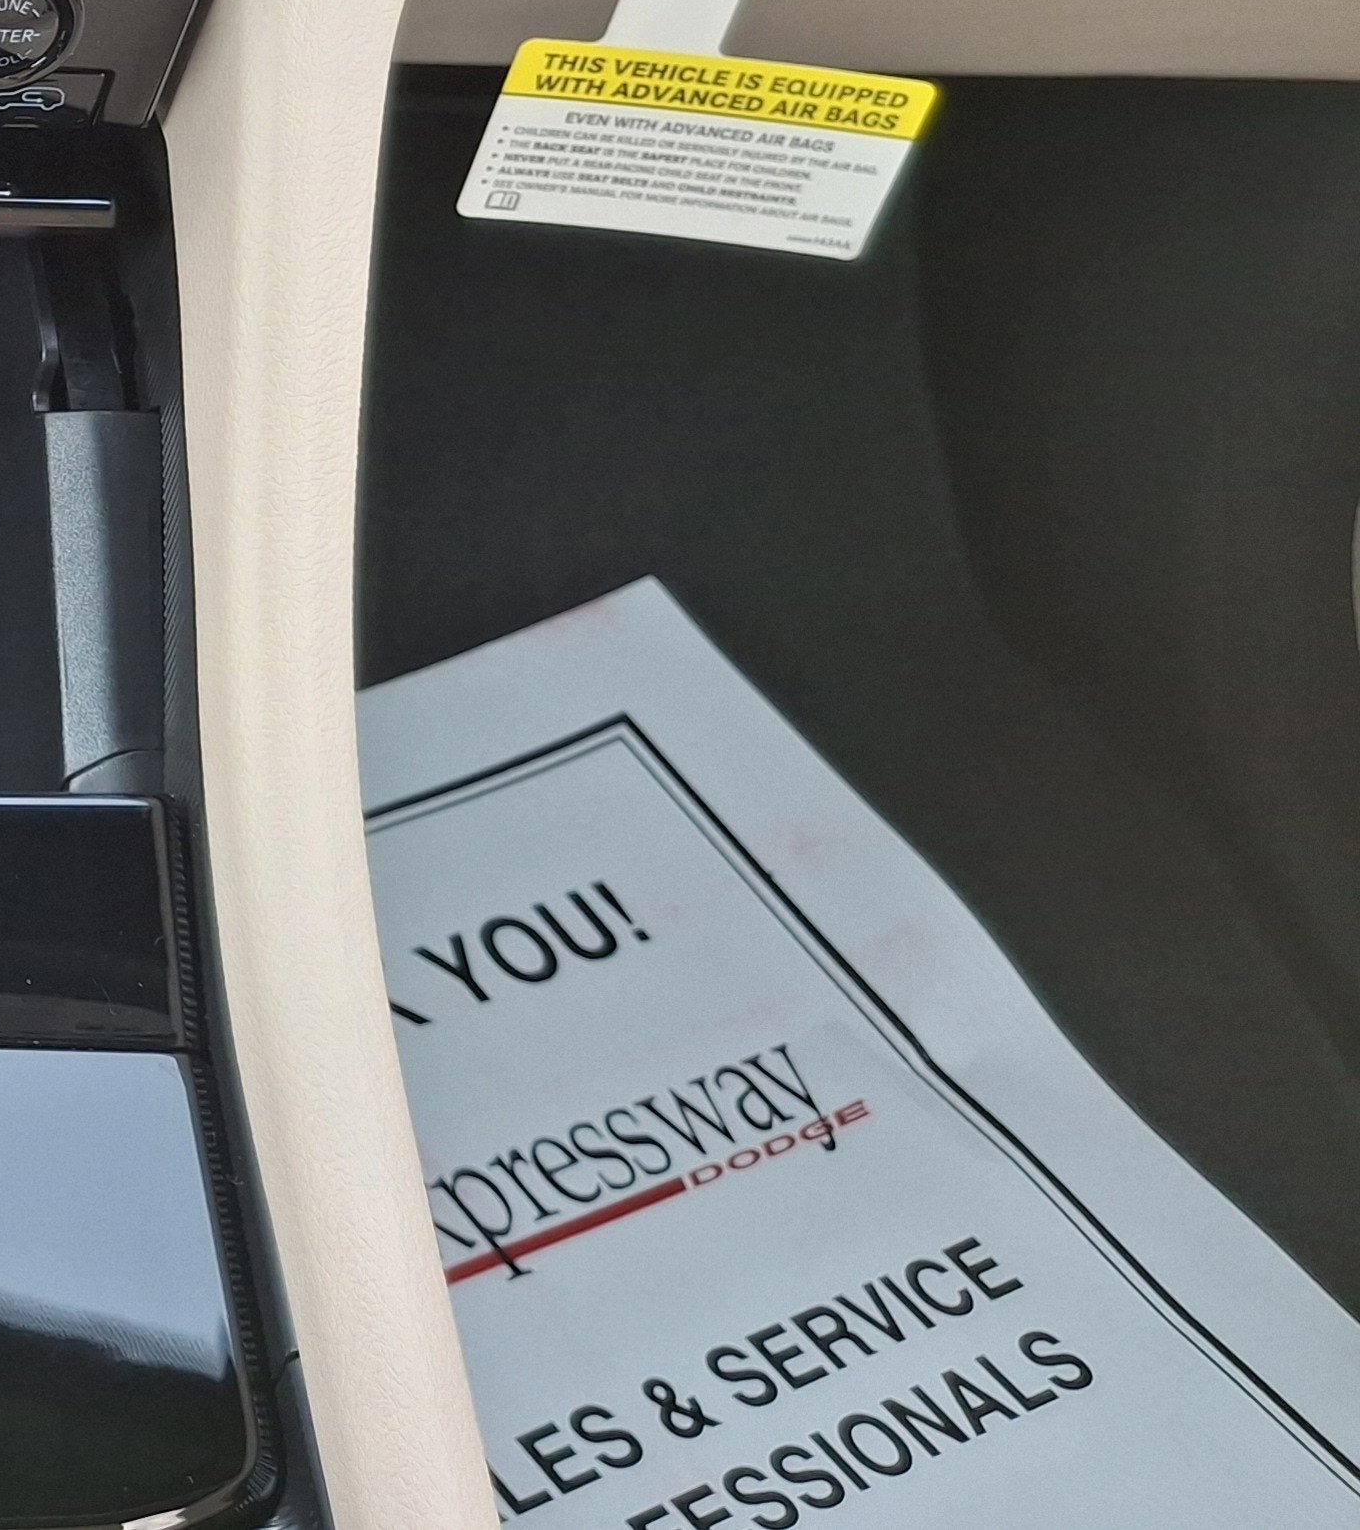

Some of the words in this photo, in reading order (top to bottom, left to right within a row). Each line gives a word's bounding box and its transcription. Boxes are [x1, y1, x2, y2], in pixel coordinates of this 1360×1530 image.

[535, 74, 605, 95] WITH
[612, 83, 763, 112] ADVANCED
[770, 100, 818, 120] AIR
[827, 107, 900, 131] BAGS
[544, 53, 606, 73] THIS
[615, 59, 728, 87] VEHICLE
[735, 72, 764, 90] IS
[770, 77, 910, 109] EQUIPPED
[565, 111, 611, 127] EVEN
[613, 116, 657, 131] WITH
[660, 121, 754, 142] ADVANCED
[756, 132, 786, 147] AIR
[789, 136, 836, 153] BAGS
[413, 881, 652, 1004] YOU!
[433, 1043, 838, 1282] pressway
[688, 1100, 870, 1189] DODGE
[486, 1404, 644, 1518] LES
[642, 1377, 723, 1440] &
[706, 1236, 1023, 1408] SERVICE
